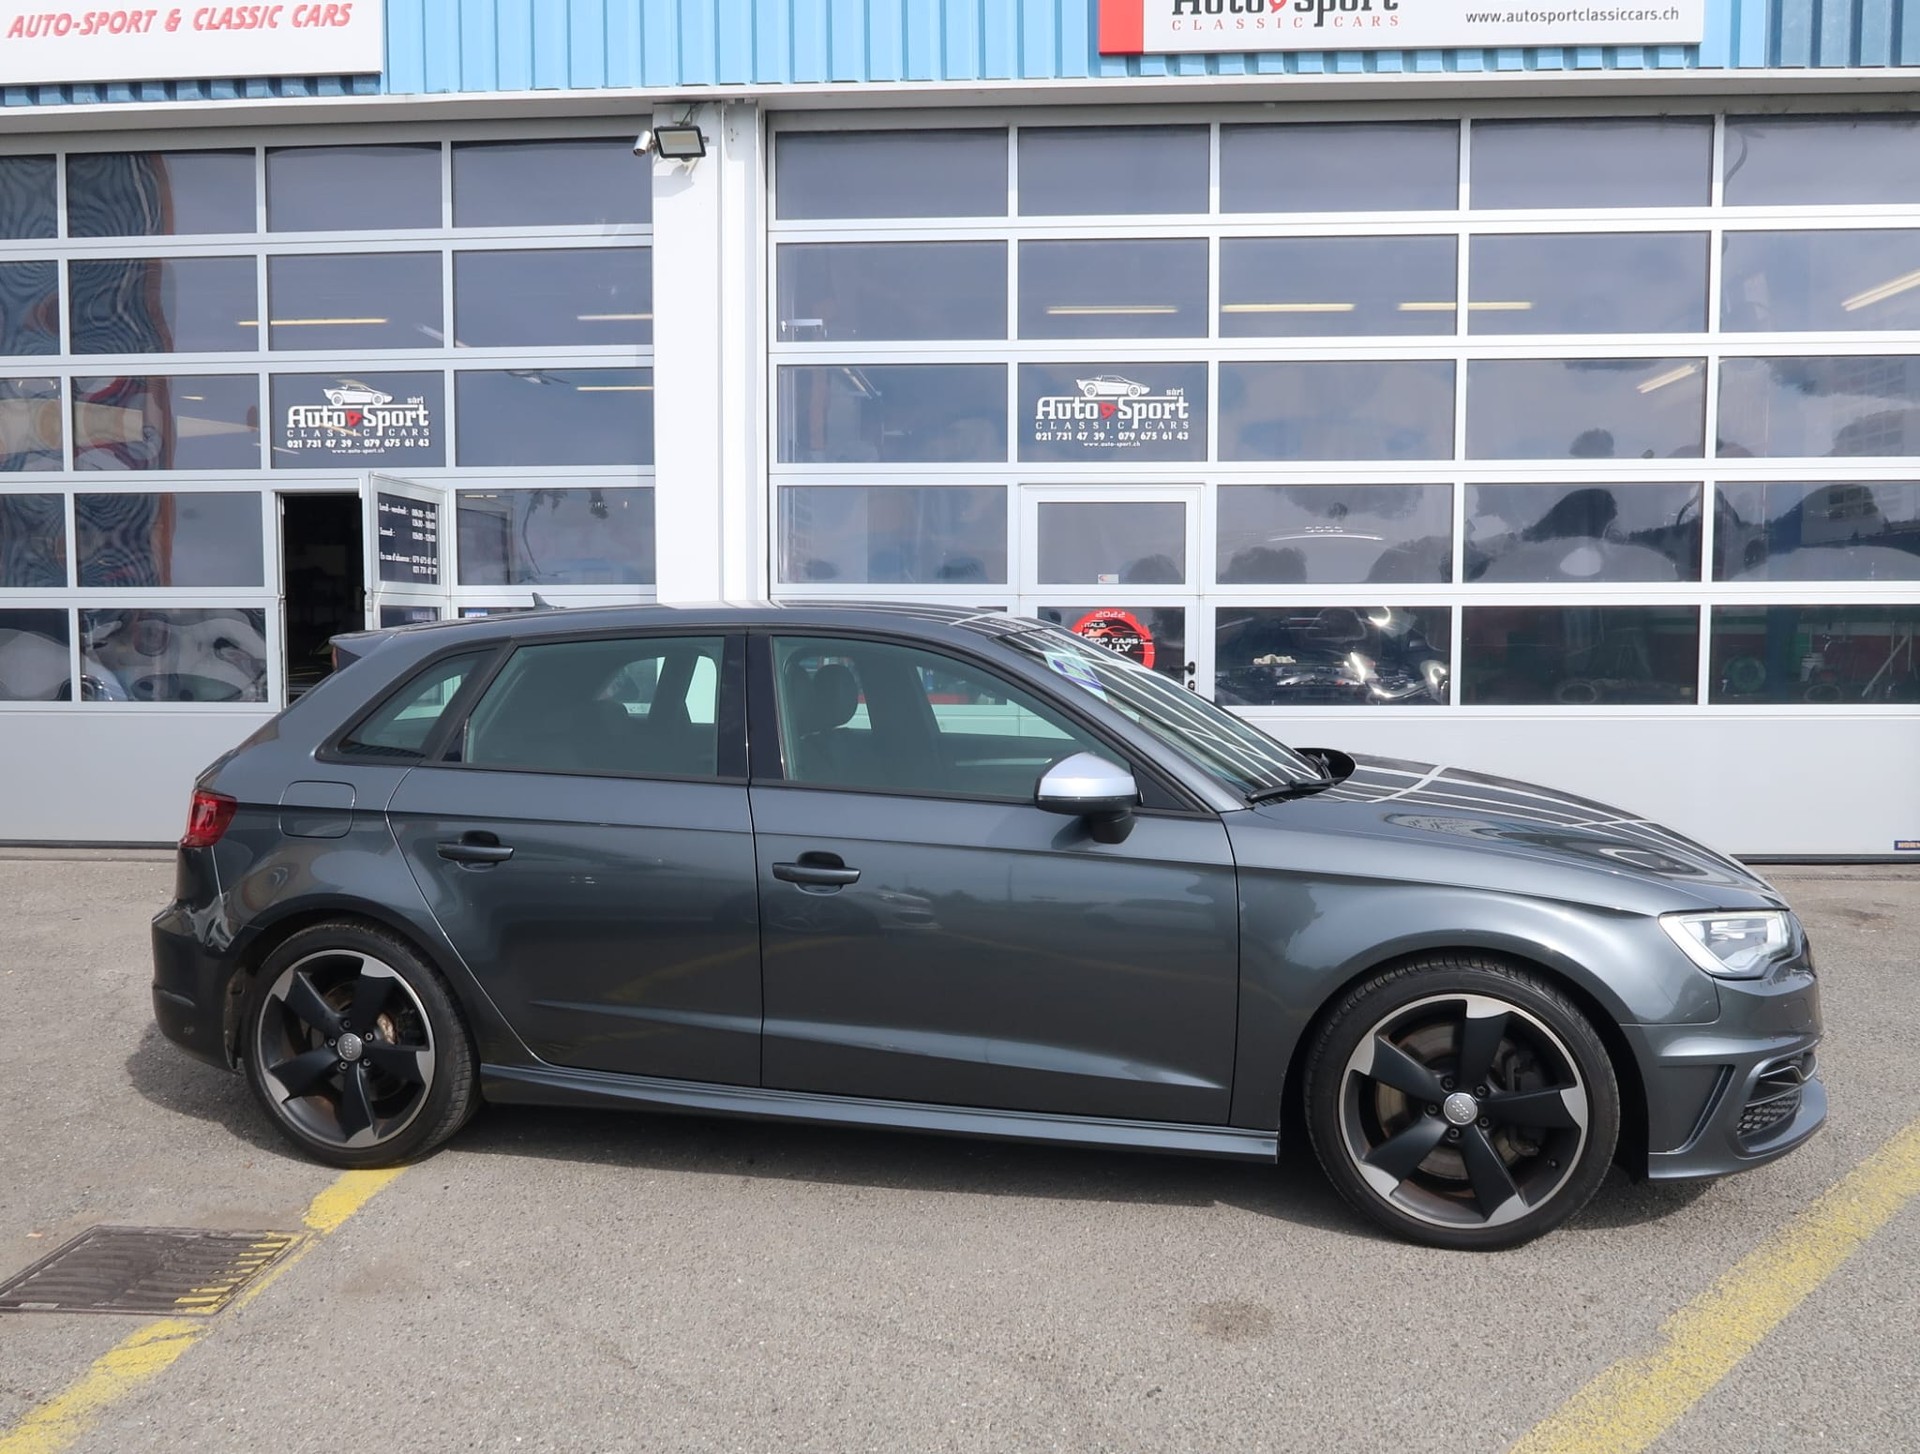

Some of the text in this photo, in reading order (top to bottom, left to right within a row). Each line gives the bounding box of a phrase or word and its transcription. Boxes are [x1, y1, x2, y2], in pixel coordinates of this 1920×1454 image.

[7, 2, 353, 39] AUTO-SPORT & CLASSIC CARS
[1465, 7, 1680, 25] www.autosportclassiccars.ch
[1171, 15, 1399, 31] CLASSIC CARS
[1035, 396, 1189, 429] Auto Sport
[286, 404, 429, 437] Auto Sport
[1035, 421, 1189, 430] CLASSIC CARS
[286, 428, 430, 438] CLASSIC CARS
[1035, 431, 1052, 441] 021
[1056, 431, 1072, 441] 731
[1076, 431, 1089, 441] 47
[1093, 431, 1105, 441] 39
[1118, 431, 1136, 441] 079
[1140, 431, 1158, 441] 675
[1162, 431, 1172, 441] 61
[1176, 431, 1189, 441] 43
[286, 439, 303, 448] 021
[306, 439, 322, 448] 731
[325, 439, 337, 448] 47
[341, 439, 352, 448] 39
[364, 438, 380, 448] 079
[384, 438, 400, 447] 675
[404, 438, 415, 447] 61
[418, 438, 430, 447] 43
[1095, 610, 1126, 618] 2022
